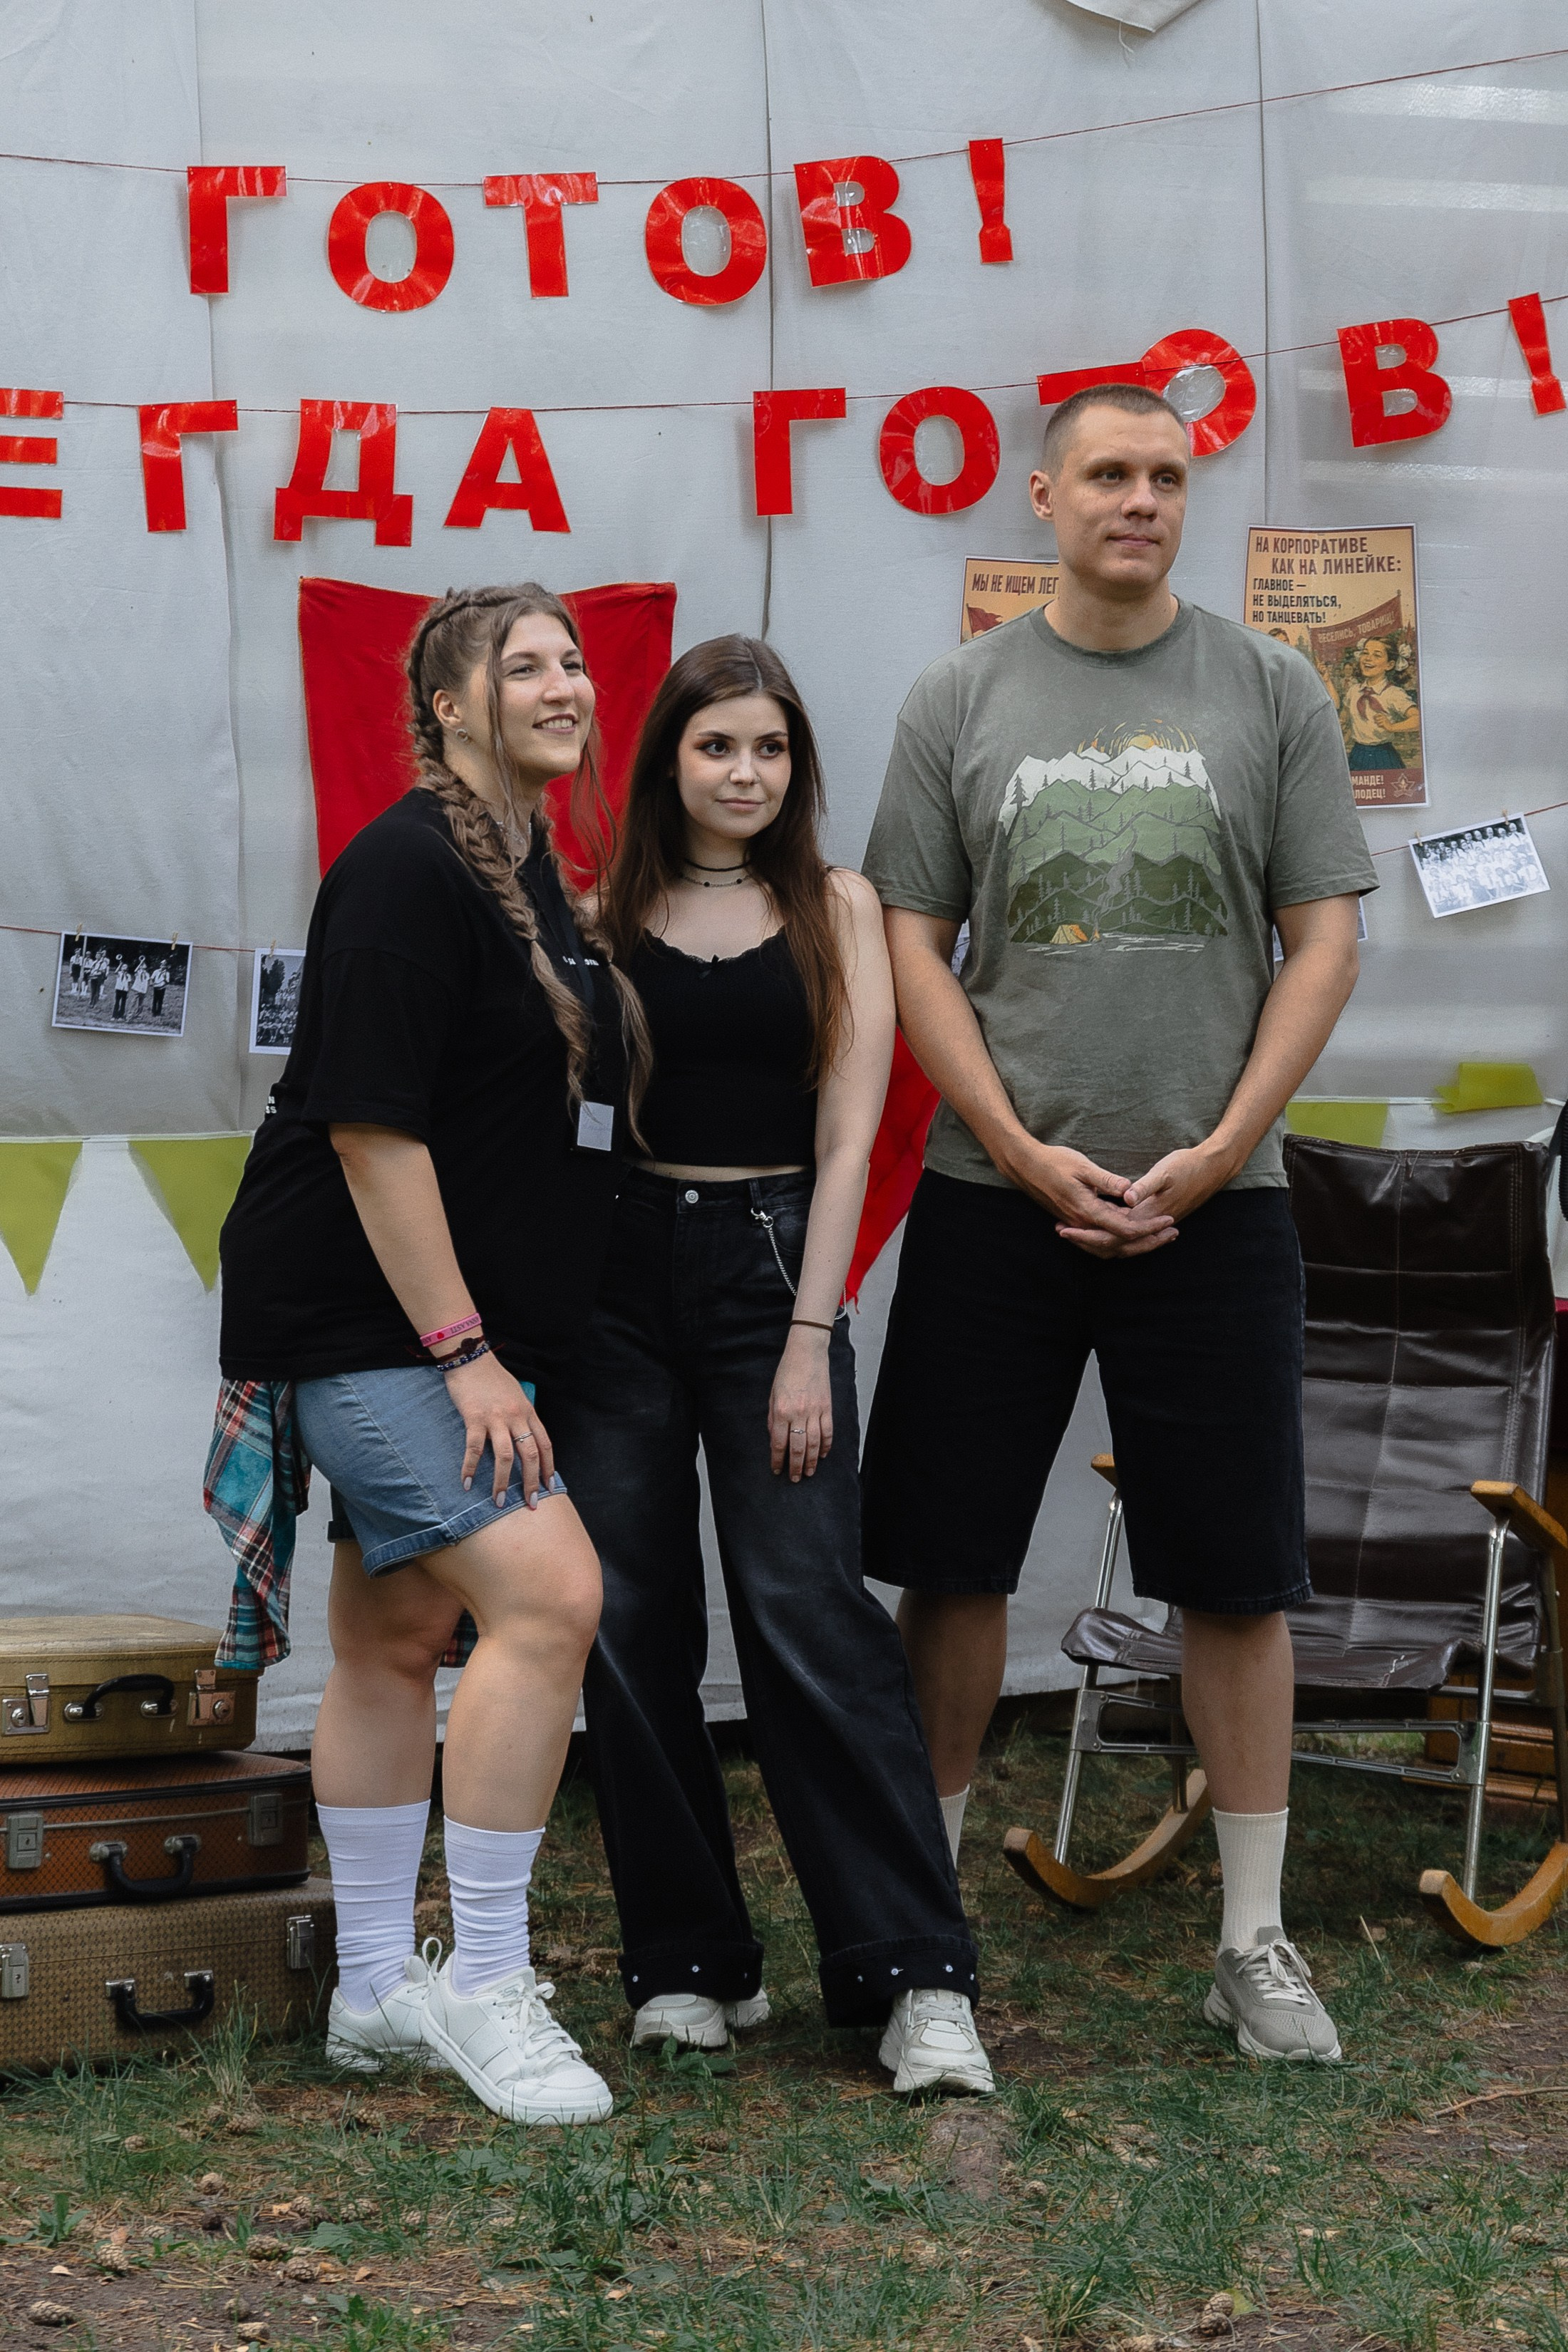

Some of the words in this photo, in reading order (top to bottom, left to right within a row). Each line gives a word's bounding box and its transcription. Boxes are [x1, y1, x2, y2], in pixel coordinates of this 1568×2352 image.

[187, 139, 1013, 311] ГОТОВ!
[1256, 537, 1269, 552] НА
[1274, 537, 1368, 554] КОРПОРАТИВЕ
[1272, 558, 1294, 574] КАК
[1299, 559, 1317, 574] НА
[1323, 554, 1401, 574] ЛИНЕЙКЕ:
[971, 573, 989, 592] МЫ
[991, 574, 1004, 593] НЕ
[1005, 575, 1036, 596] ИЩЕМ
[1253, 578, 1294, 591] ГЛАВНОЕ
[1253, 594, 1264, 606] НЕ
[1267, 594, 1341, 609] ВЫДЕЛЯТЬСЯ,
[1252, 611, 1264, 622] НО
[1267, 611, 1326, 624] ТАНЦЕВАТЬ!
